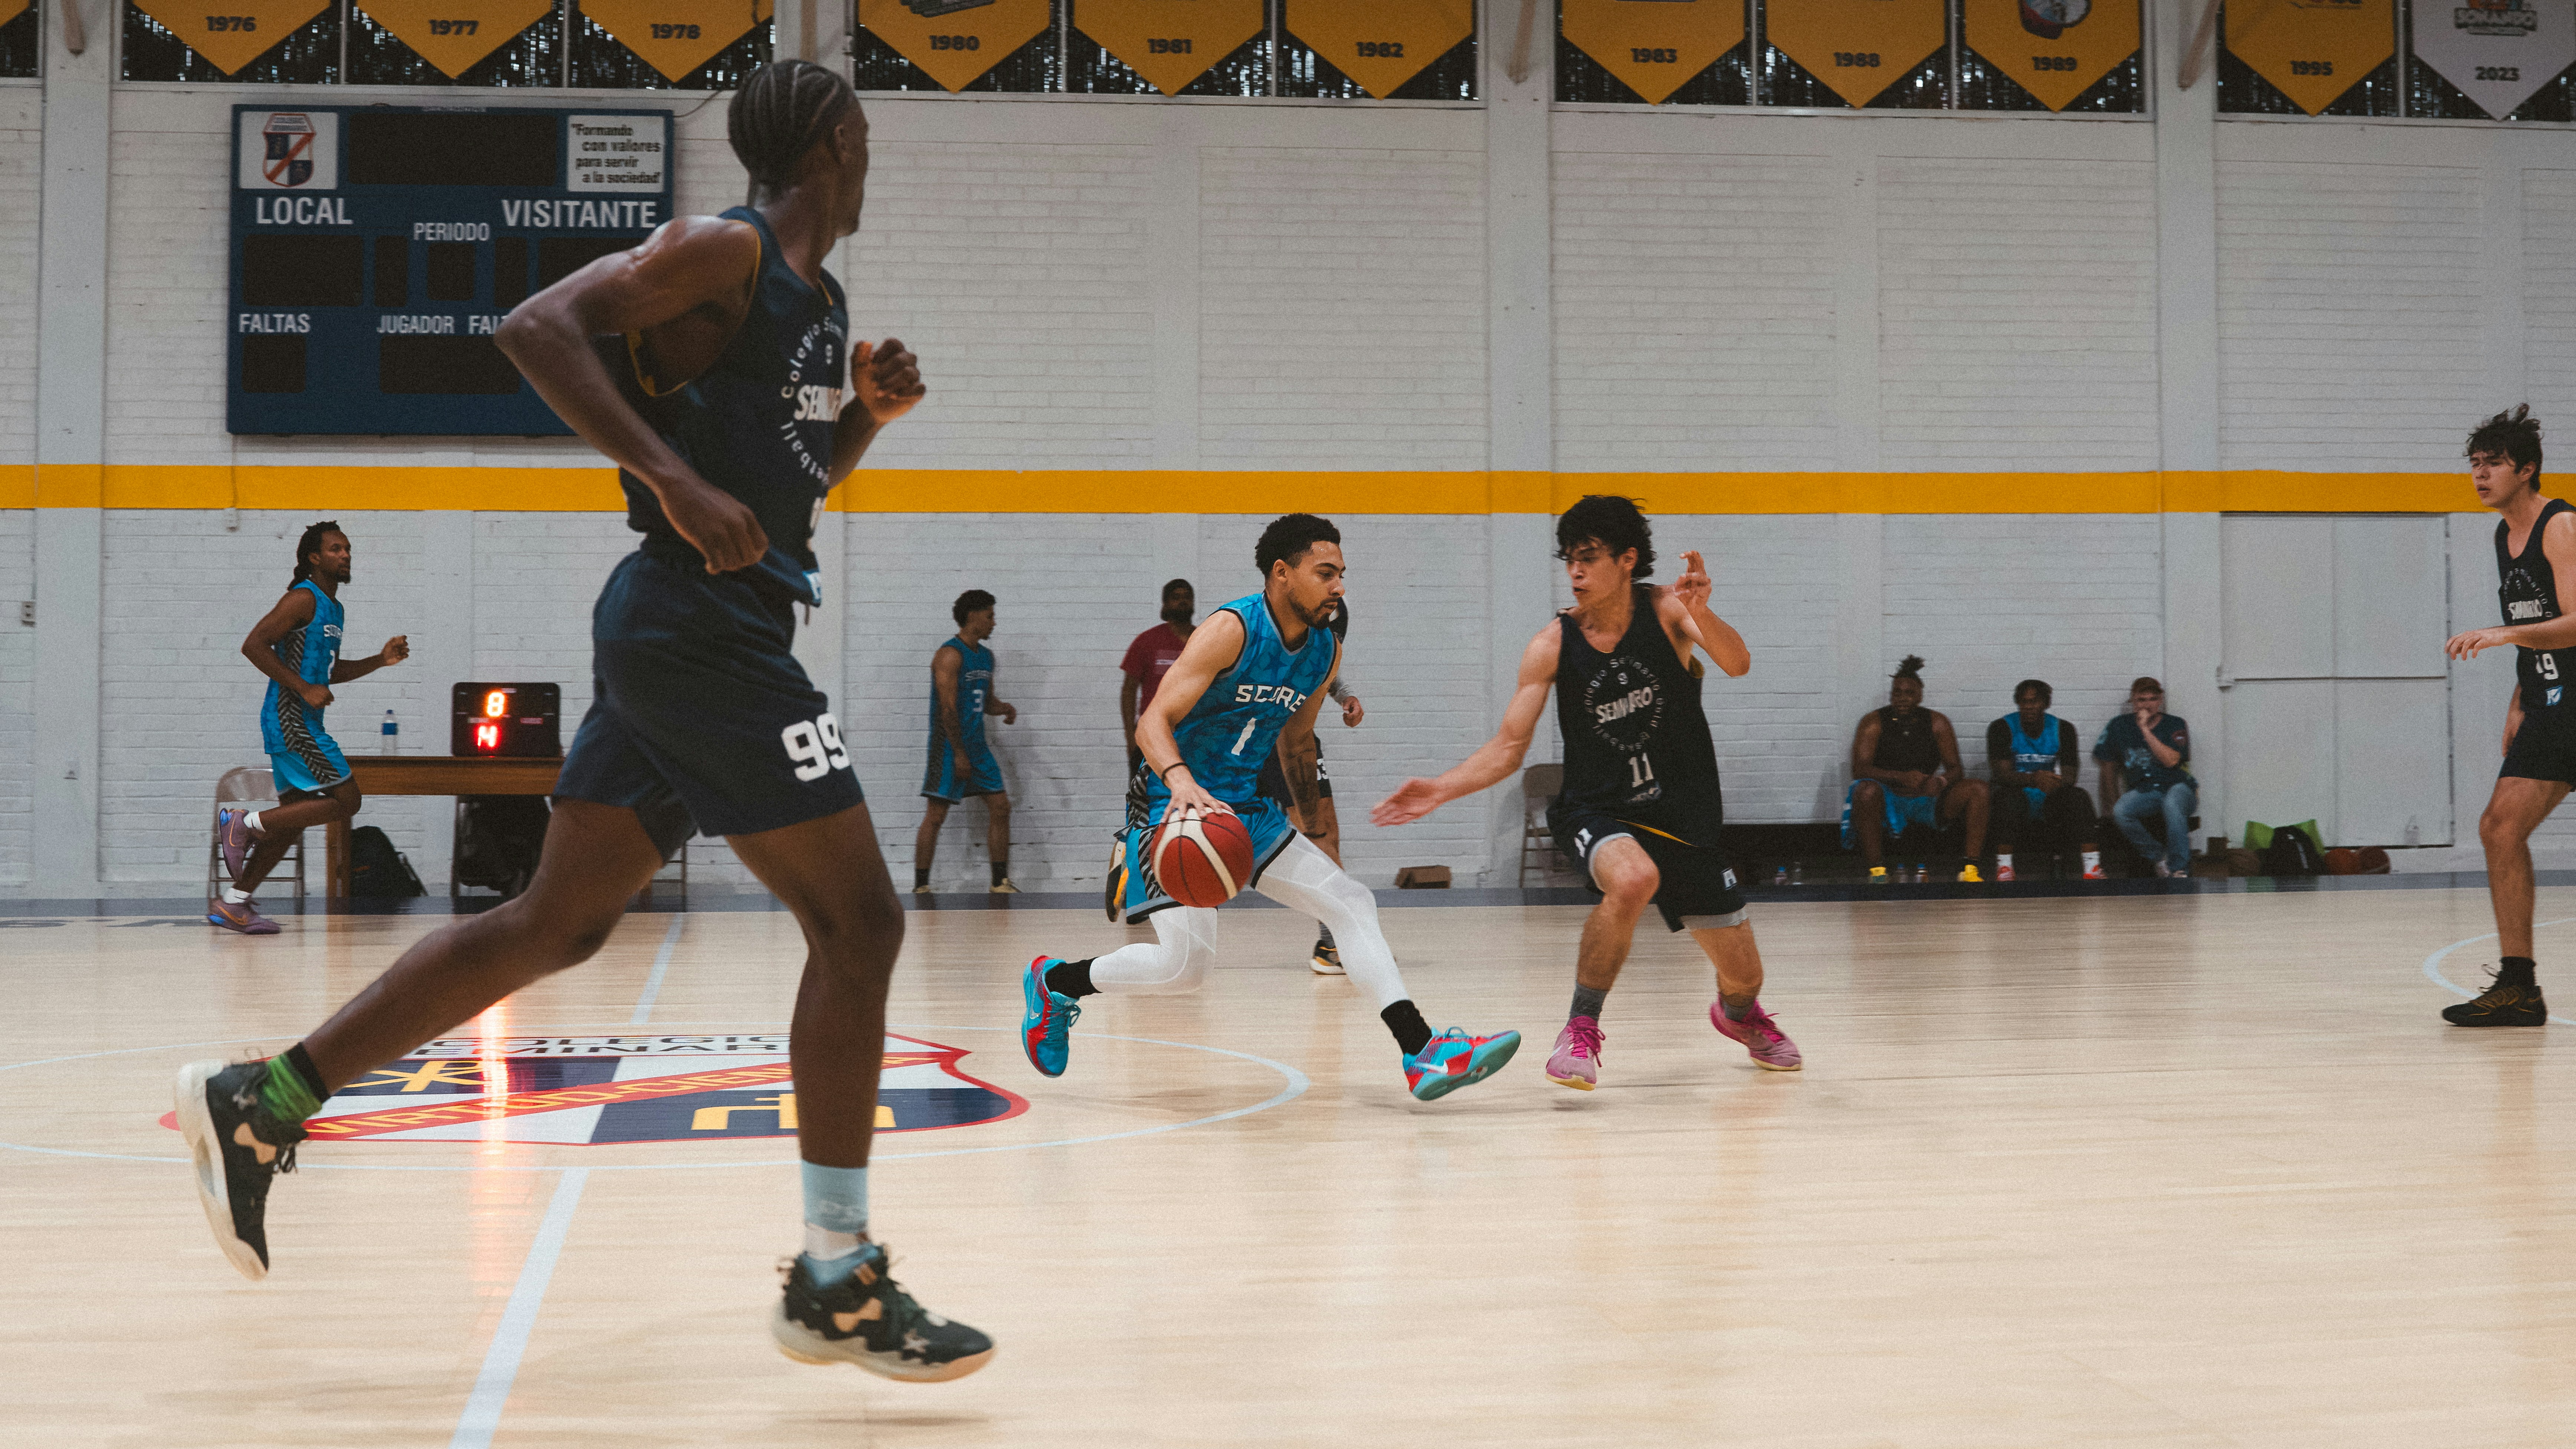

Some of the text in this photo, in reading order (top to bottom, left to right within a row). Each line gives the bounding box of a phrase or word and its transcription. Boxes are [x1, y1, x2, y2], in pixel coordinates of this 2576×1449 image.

[207, 16, 257, 32] 1976
[429, 19, 479, 36] 1977
[650, 23, 701, 40] 1978
[929, 35, 980, 51] 1980
[1147, 39, 1193, 55] 1981
[1356, 42, 1404, 58] 1982
[1630, 48, 1678, 63] 1983
[1834, 53, 1881, 68] 1988
[2032, 56, 2077, 71] 1989
[2475, 66, 2520, 82] 2023
[582, 138, 660, 152] con valores
[575, 155, 639, 170] para servir
[582, 174, 591, 183] a
[592, 171, 605, 183] la
[256, 197, 354, 225] LOCAL
[501, 199, 657, 229] VISITANTE
[413, 222, 490, 242] PERIODO
[238, 313, 311, 333] FALTAS
[376, 315, 505, 334] JUGADOR FAL
[486, 691, 506, 717] 8
[972, 689, 984, 713] 3
[1231, 717, 1258, 756] 1
[781, 712, 851, 782] 99
[1628, 752, 1655, 788] 11
[413, 1044, 778, 1055] EMINAR
[433, 1036, 791, 1047] COLEGIO
[306, 1057, 940, 1134] VIRTUD-CIENA
